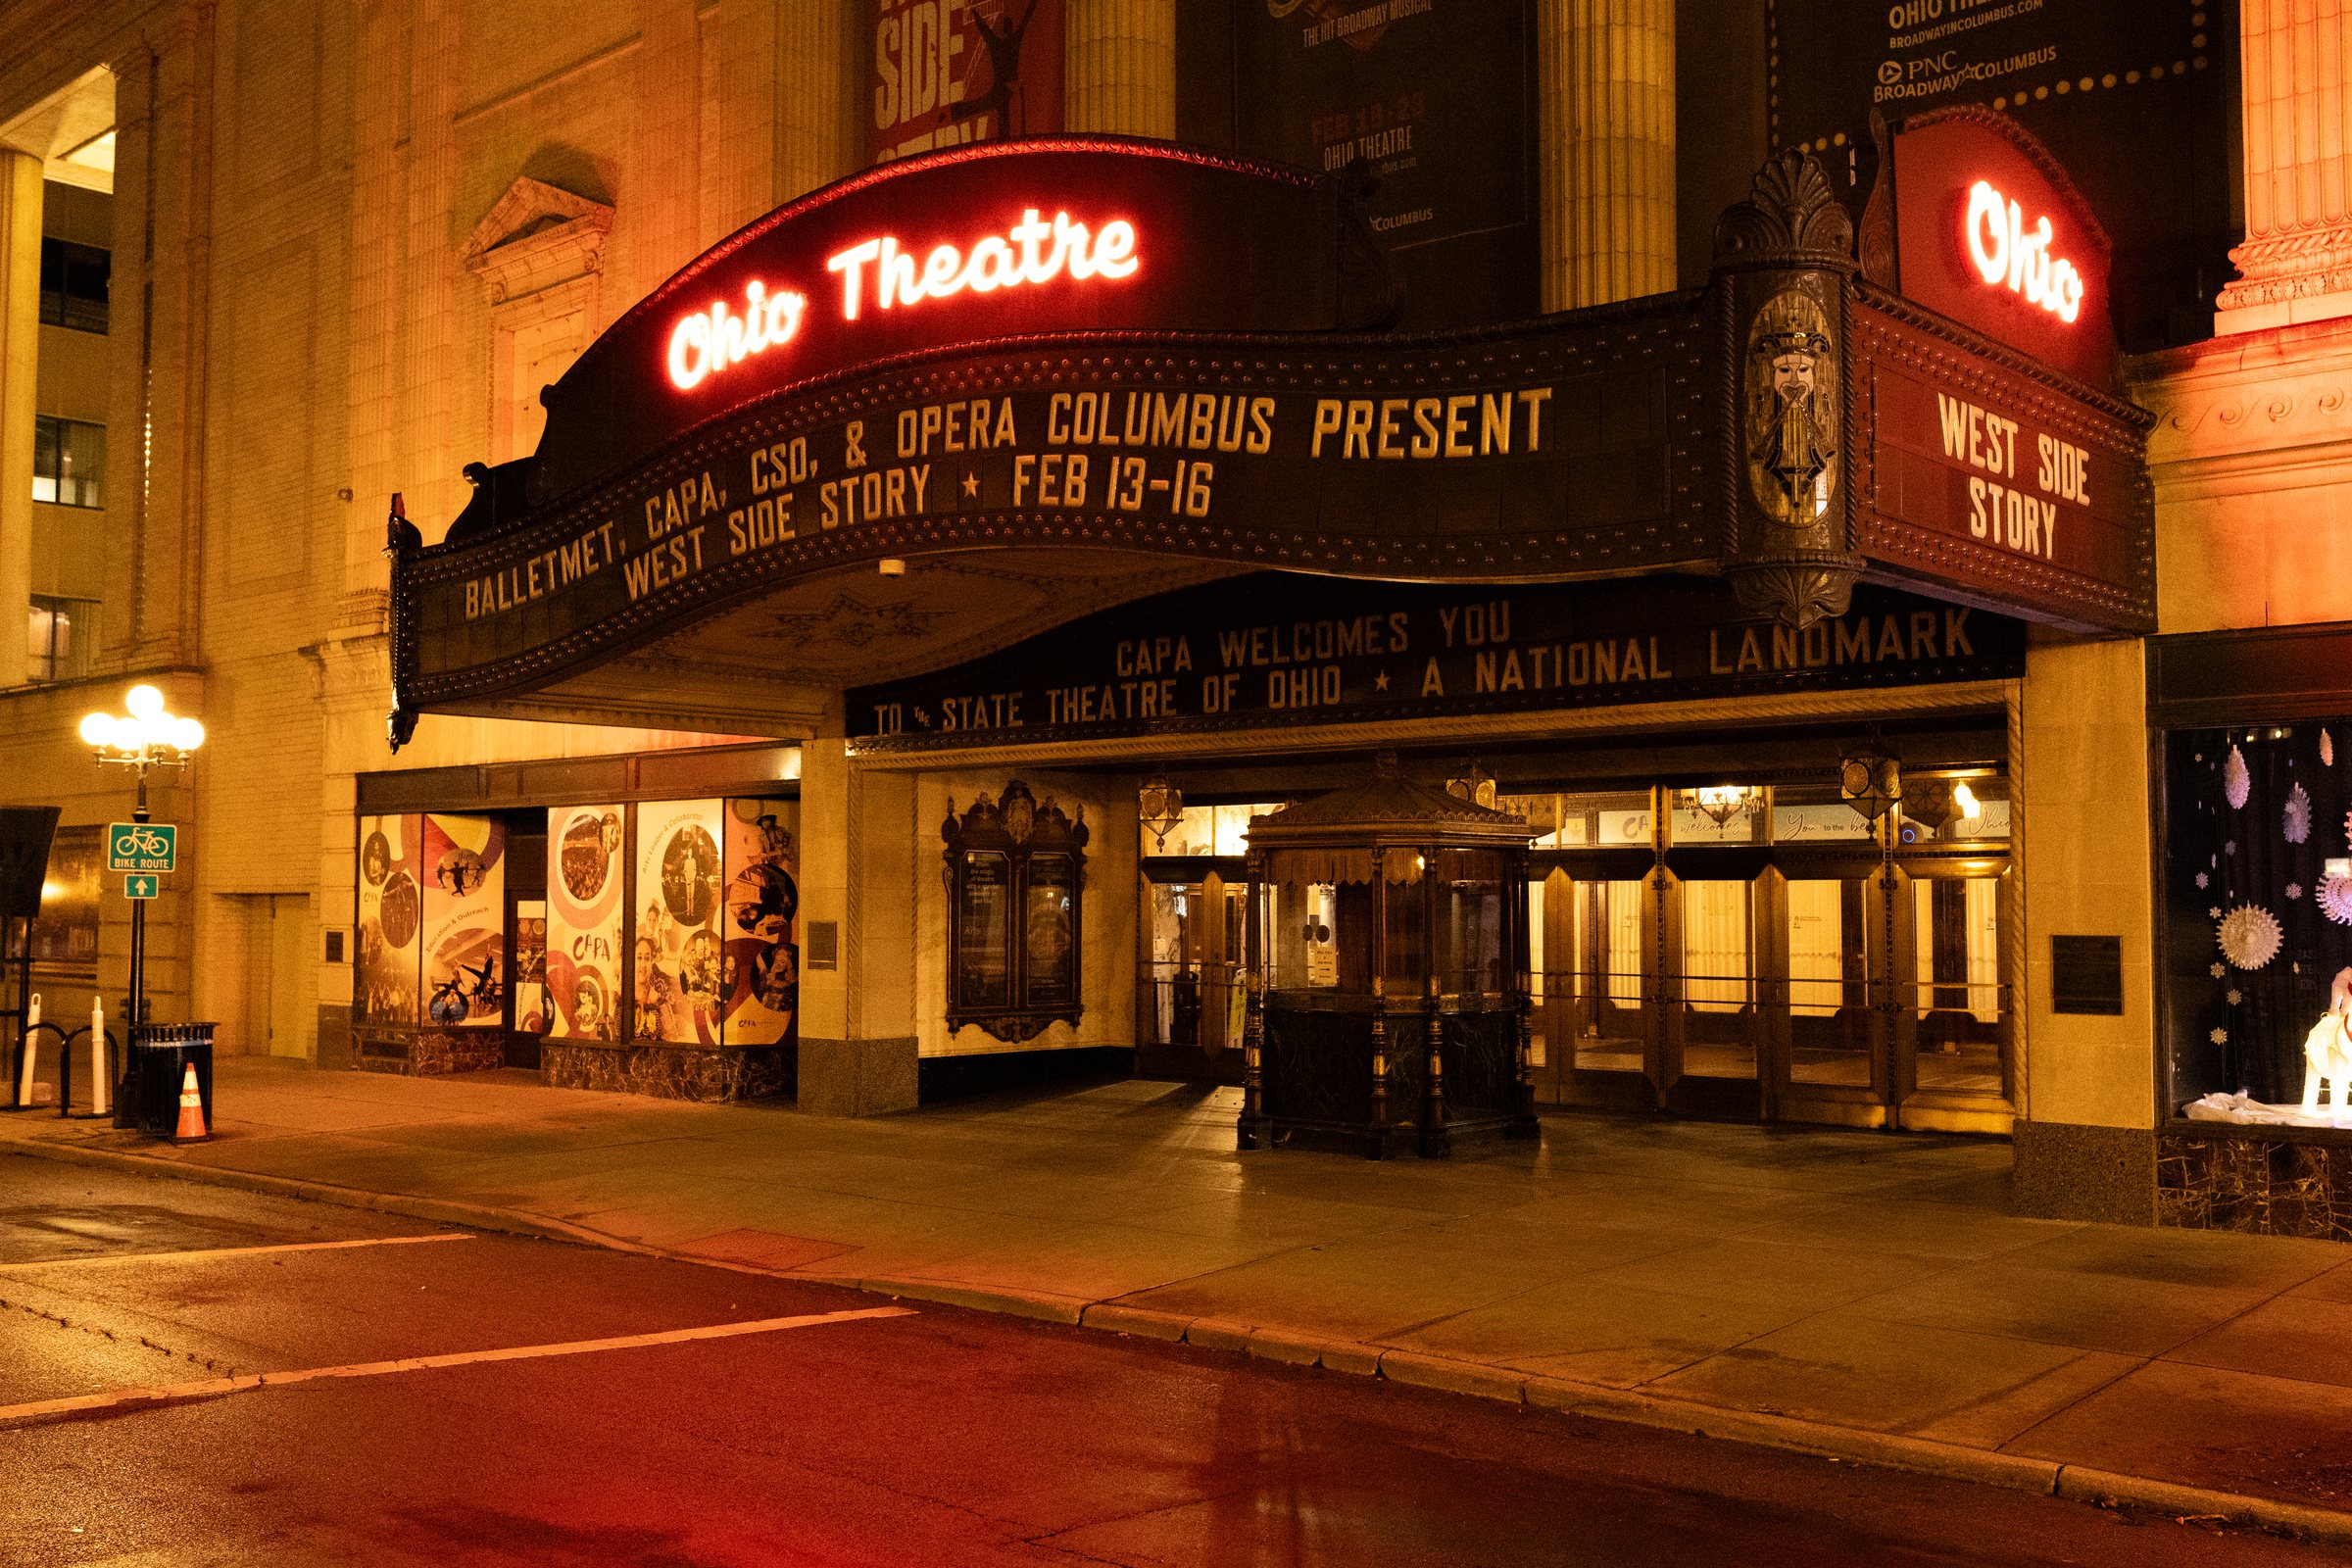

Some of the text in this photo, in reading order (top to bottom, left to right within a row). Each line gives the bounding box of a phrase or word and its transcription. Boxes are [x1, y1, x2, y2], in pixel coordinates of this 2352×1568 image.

[875, 0, 964, 130] SIDE
[1303, 25, 1319, 47] THE
[1321, 20, 1335, 42] HIT
[1337, 2, 1388, 37] BROADWAY
[1906, 50, 1957, 79] PNC
[1874, 46, 2057, 103] BROADWAY COLUMBUS
[1324, 124, 1412, 172] OHIO THEATRE
[1968, 180, 2083, 322] Ohio
[667, 209, 1139, 390] Ohio Theatre
[1937, 392, 2090, 506] WEST SIDE
[466, 387, 1552, 621] BALLETMET, CAPA, CSO, & OPERA COLUMBUS PRESENT
[623, 454, 1214, 602] WEST SIDE STORY FEB 13-16
[1970, 476, 2056, 560] STORY
[874, 703, 903, 736] TO
[942, 691, 1023, 733] STATE
[1046, 677, 1176, 724] THEATRE
[1203, 673, 1241, 713] OF
[1268, 664, 1342, 710] OHIO
[1420, 657, 1445, 698] A
[1476, 636, 1672, 695] NATIONAL
[1709, 607, 1974, 674] LANDMARK
[1117, 600, 1510, 678] CAPA WELCOMES YOU
[114, 858, 170, 869] BIKE ROUTE
[1784, 812, 1817, 840] You
[572, 934, 610, 962] CAPA
